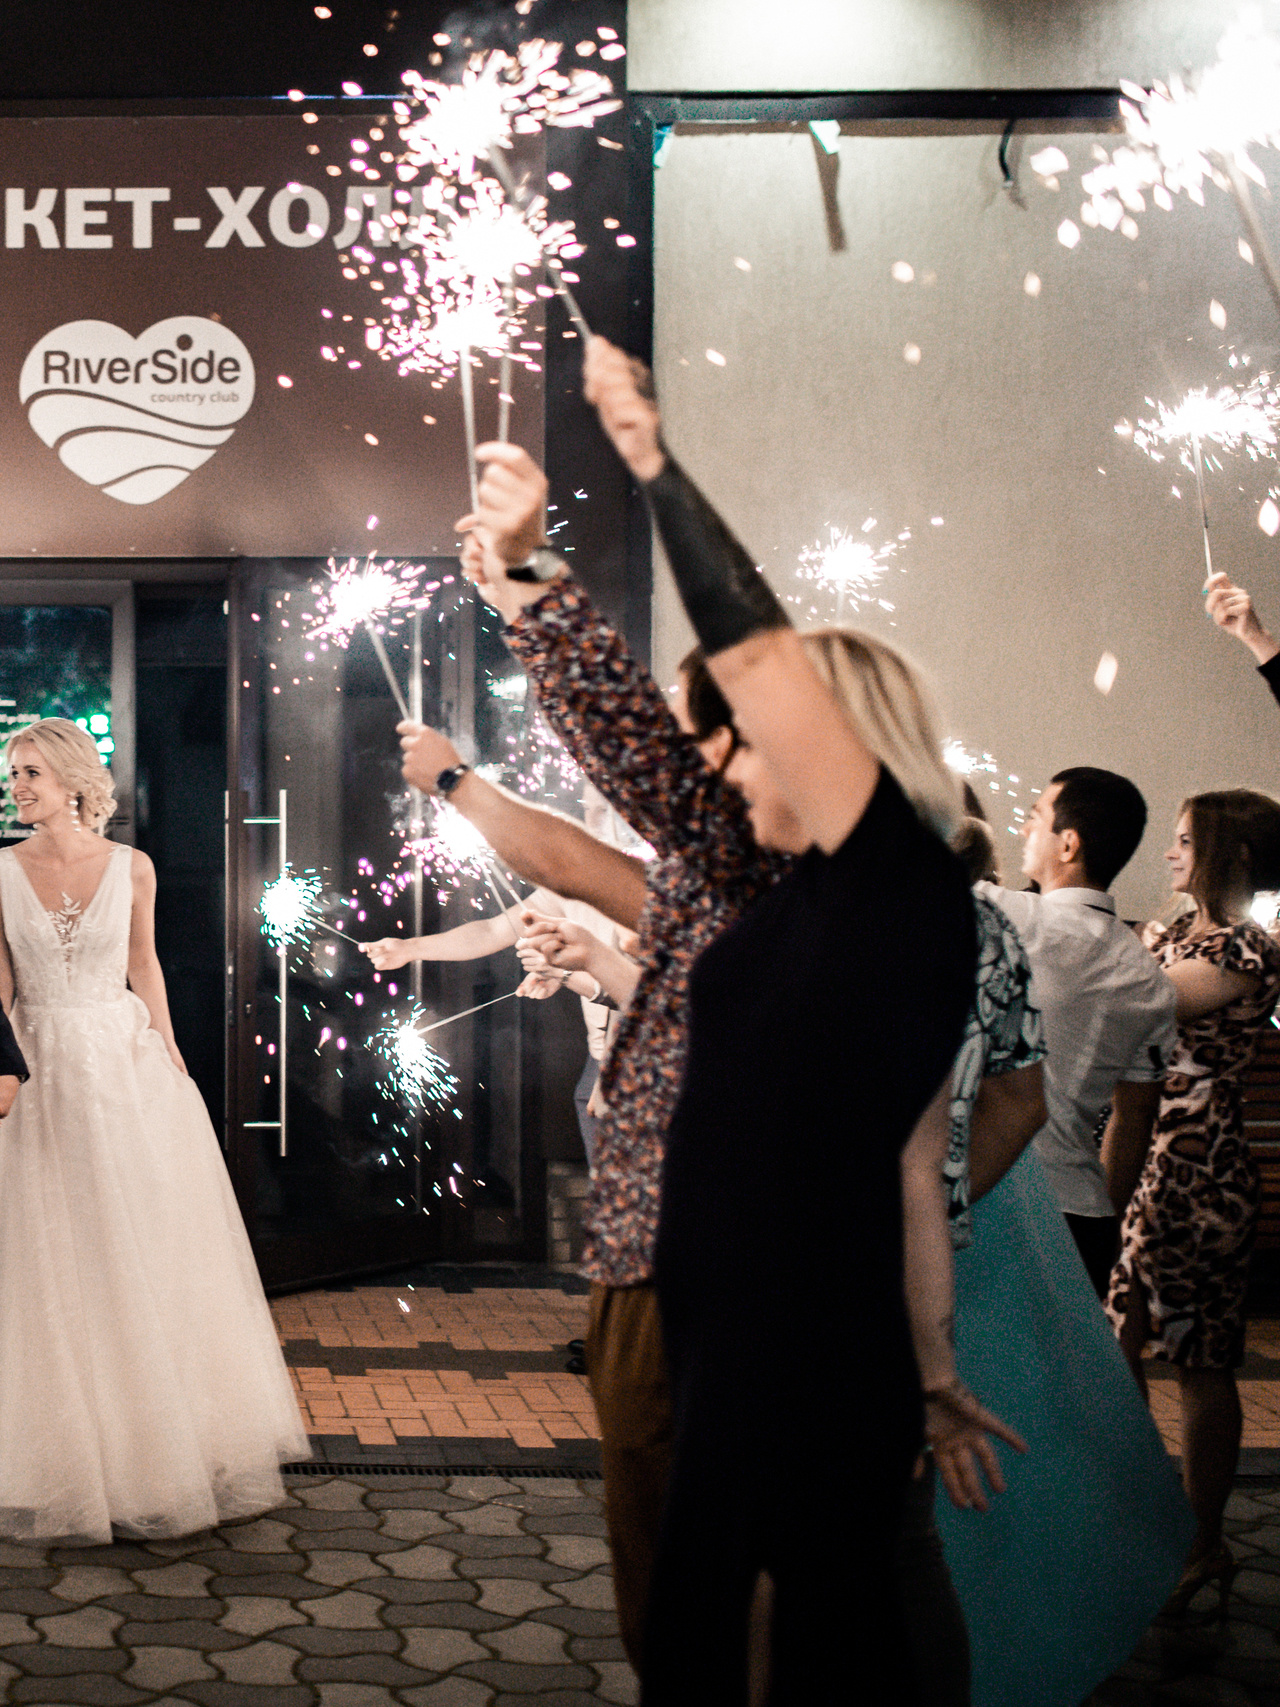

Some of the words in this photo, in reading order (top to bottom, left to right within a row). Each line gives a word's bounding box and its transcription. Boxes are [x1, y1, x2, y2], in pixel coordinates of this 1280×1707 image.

[43, 335, 241, 385] RiverSide
[151, 392, 206, 406] country
[210, 391, 240, 402] club
